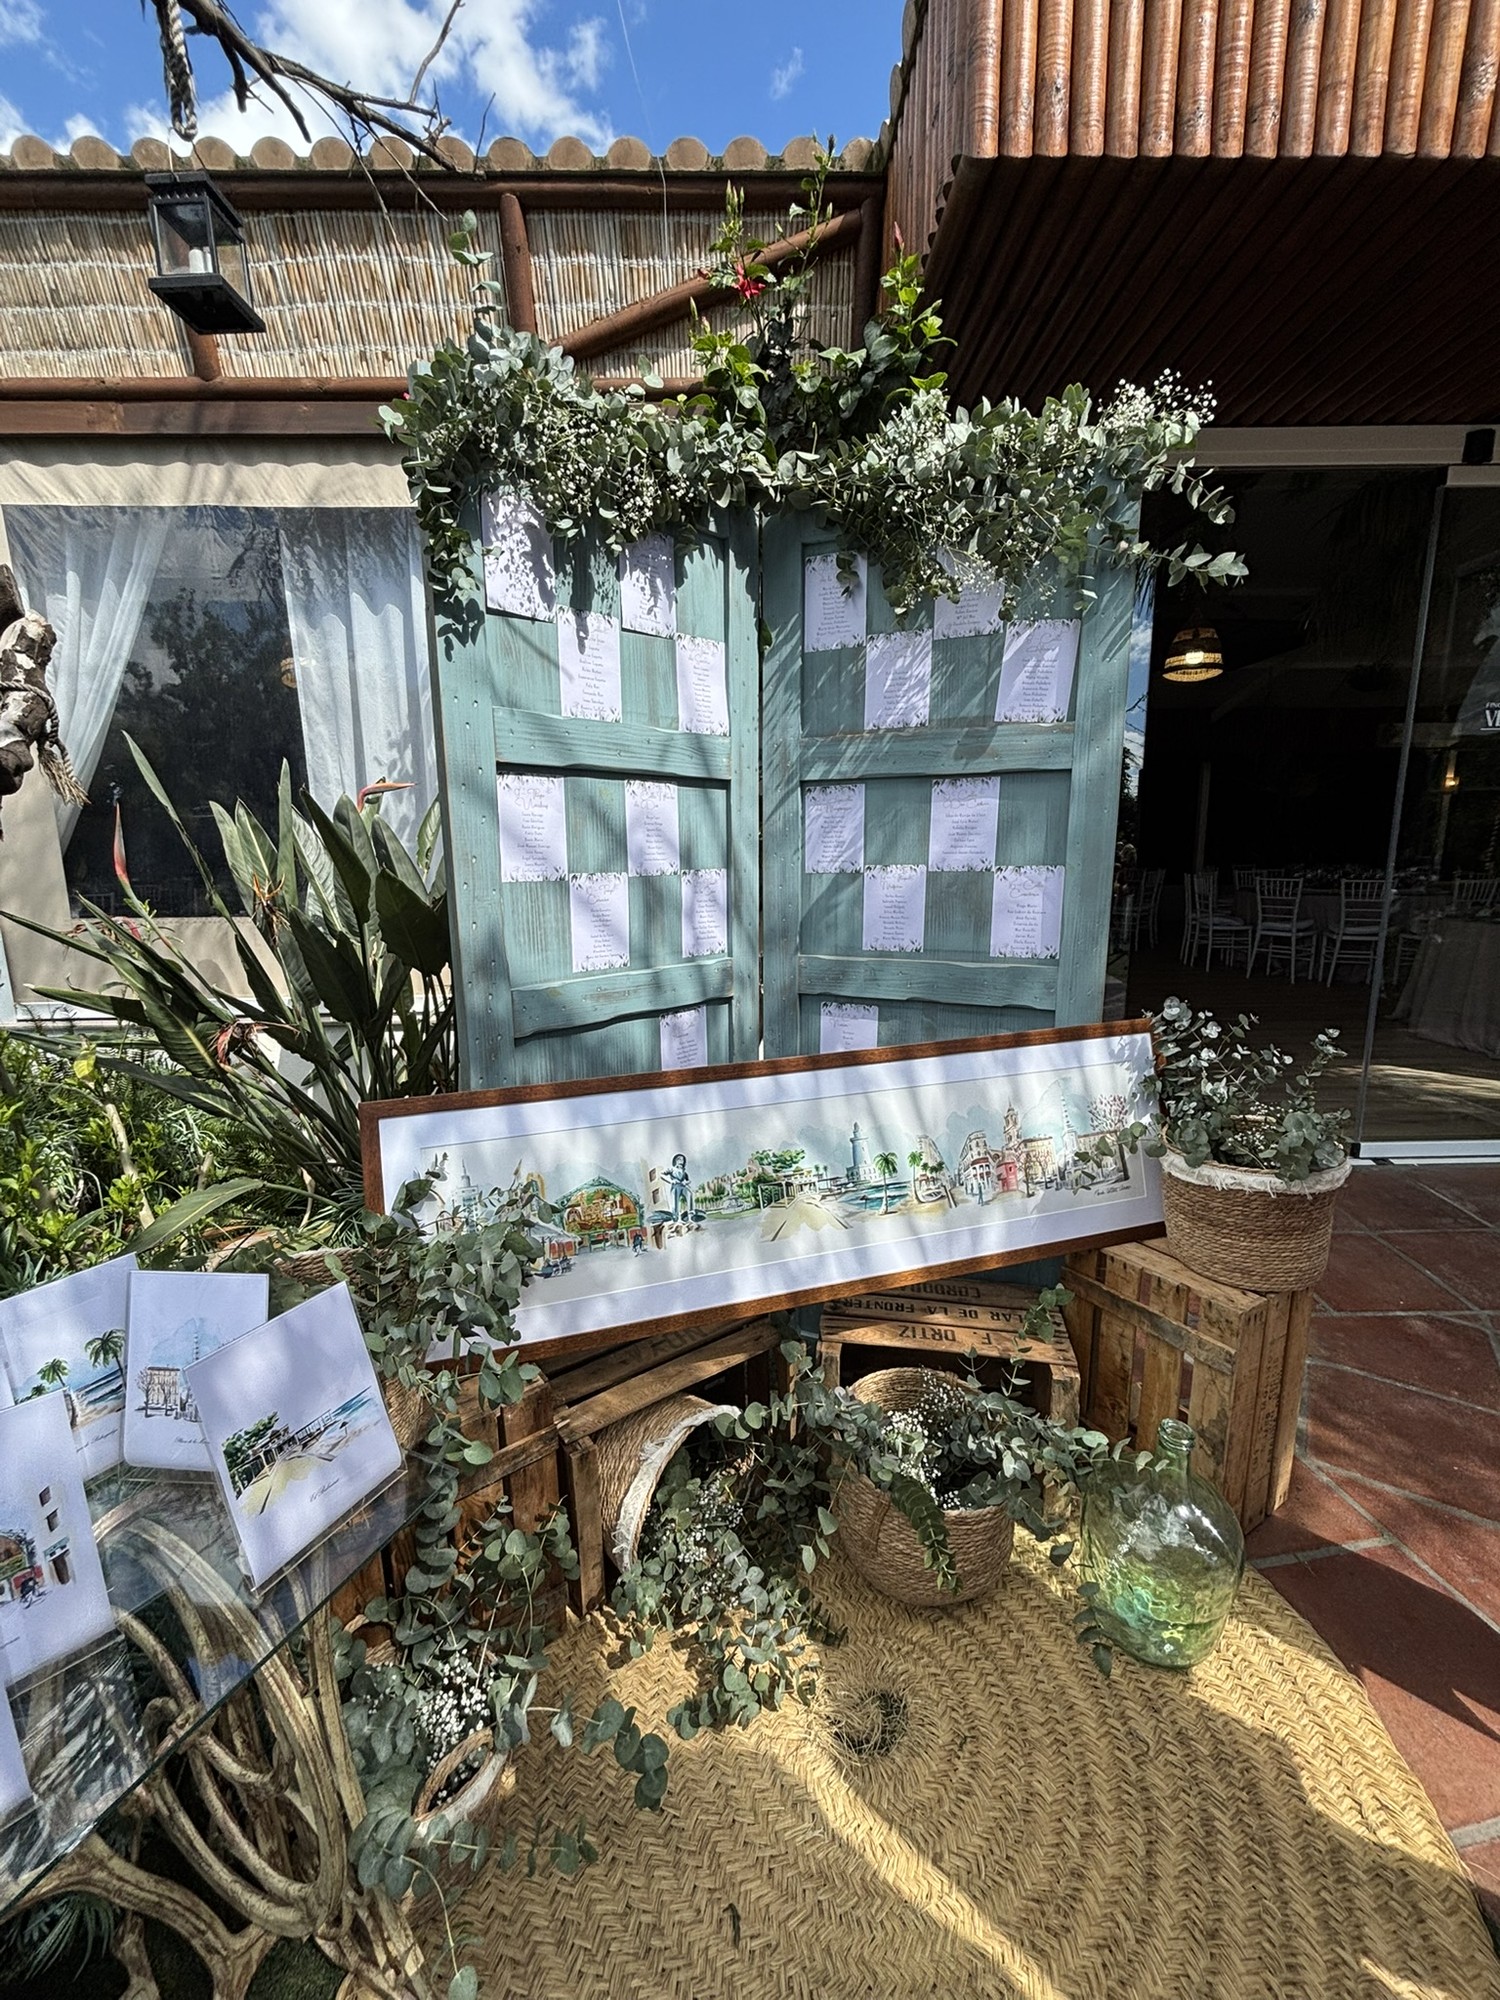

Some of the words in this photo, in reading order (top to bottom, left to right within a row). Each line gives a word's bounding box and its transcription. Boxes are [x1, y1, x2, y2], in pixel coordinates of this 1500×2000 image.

[840, 1298, 915, 1313] FRONTER
[926, 1305, 948, 1316] LA
[958, 1308, 979, 1319] DE
[898, 1325, 957, 1342] ORTIZ
[972, 1331, 993, 1345] F.
